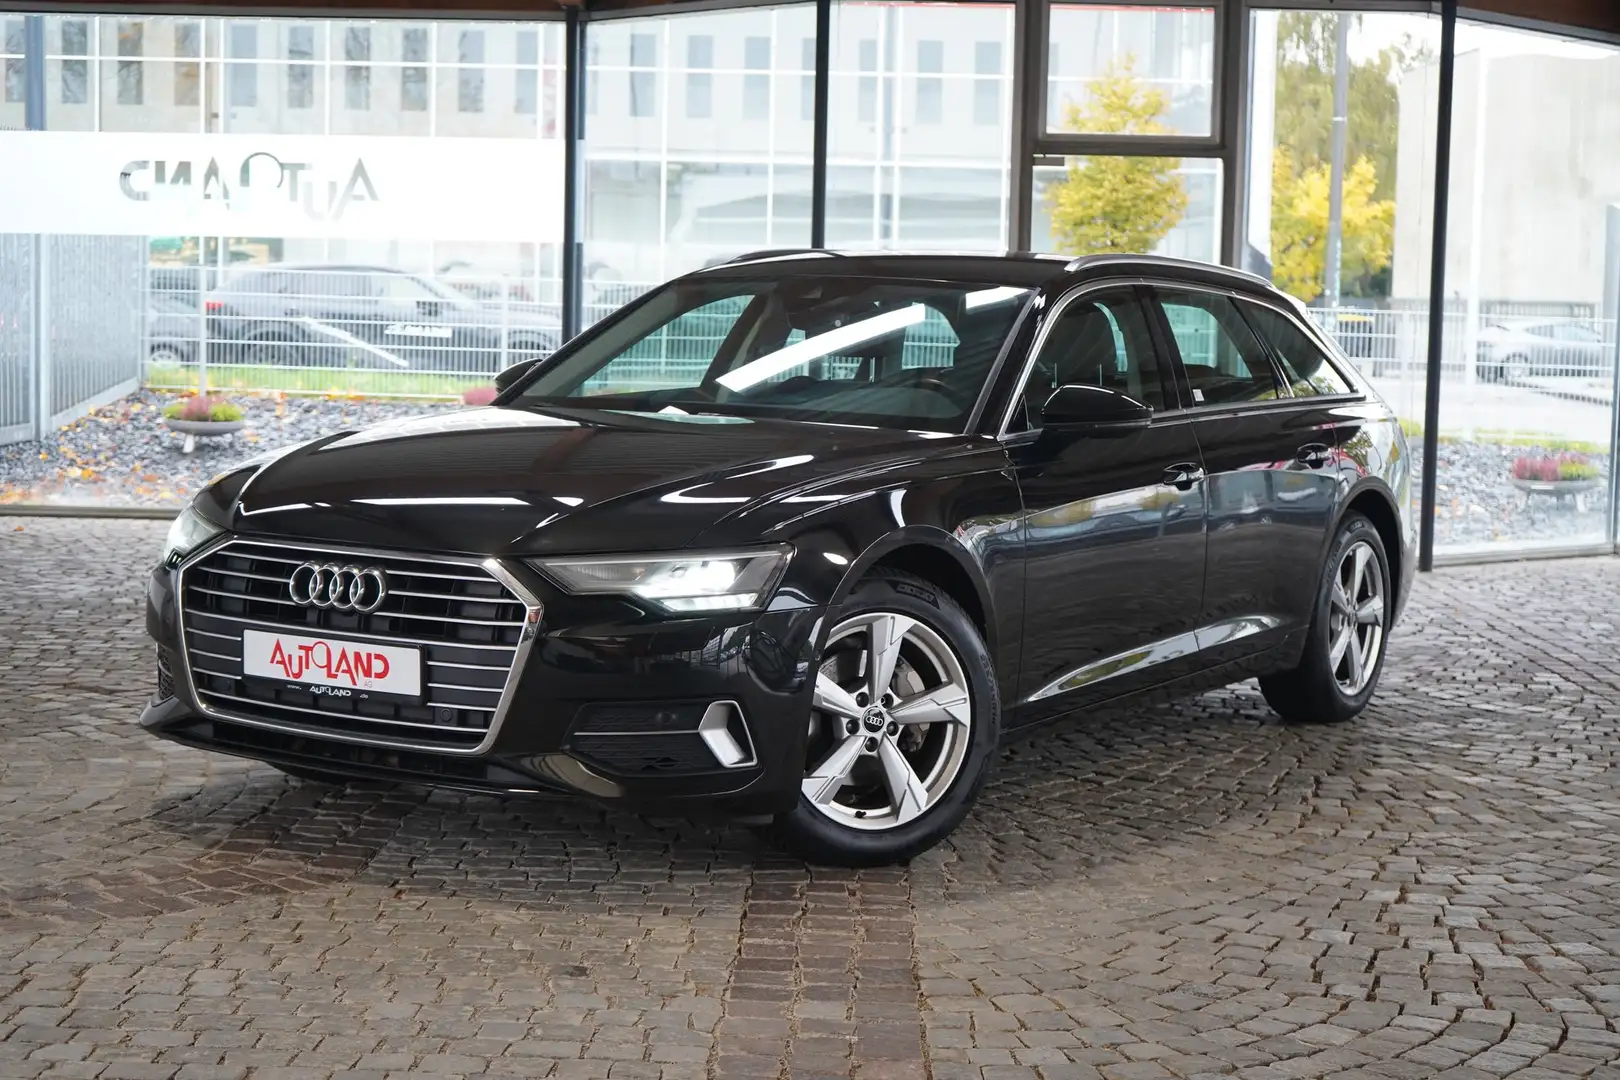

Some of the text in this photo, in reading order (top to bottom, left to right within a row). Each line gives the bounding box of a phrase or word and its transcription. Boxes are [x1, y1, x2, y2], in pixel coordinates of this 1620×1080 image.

[269, 638, 390, 686] AUTOLAND
[363, 680, 373, 689] AG
[309, 685, 352, 697] AUTOLAND
